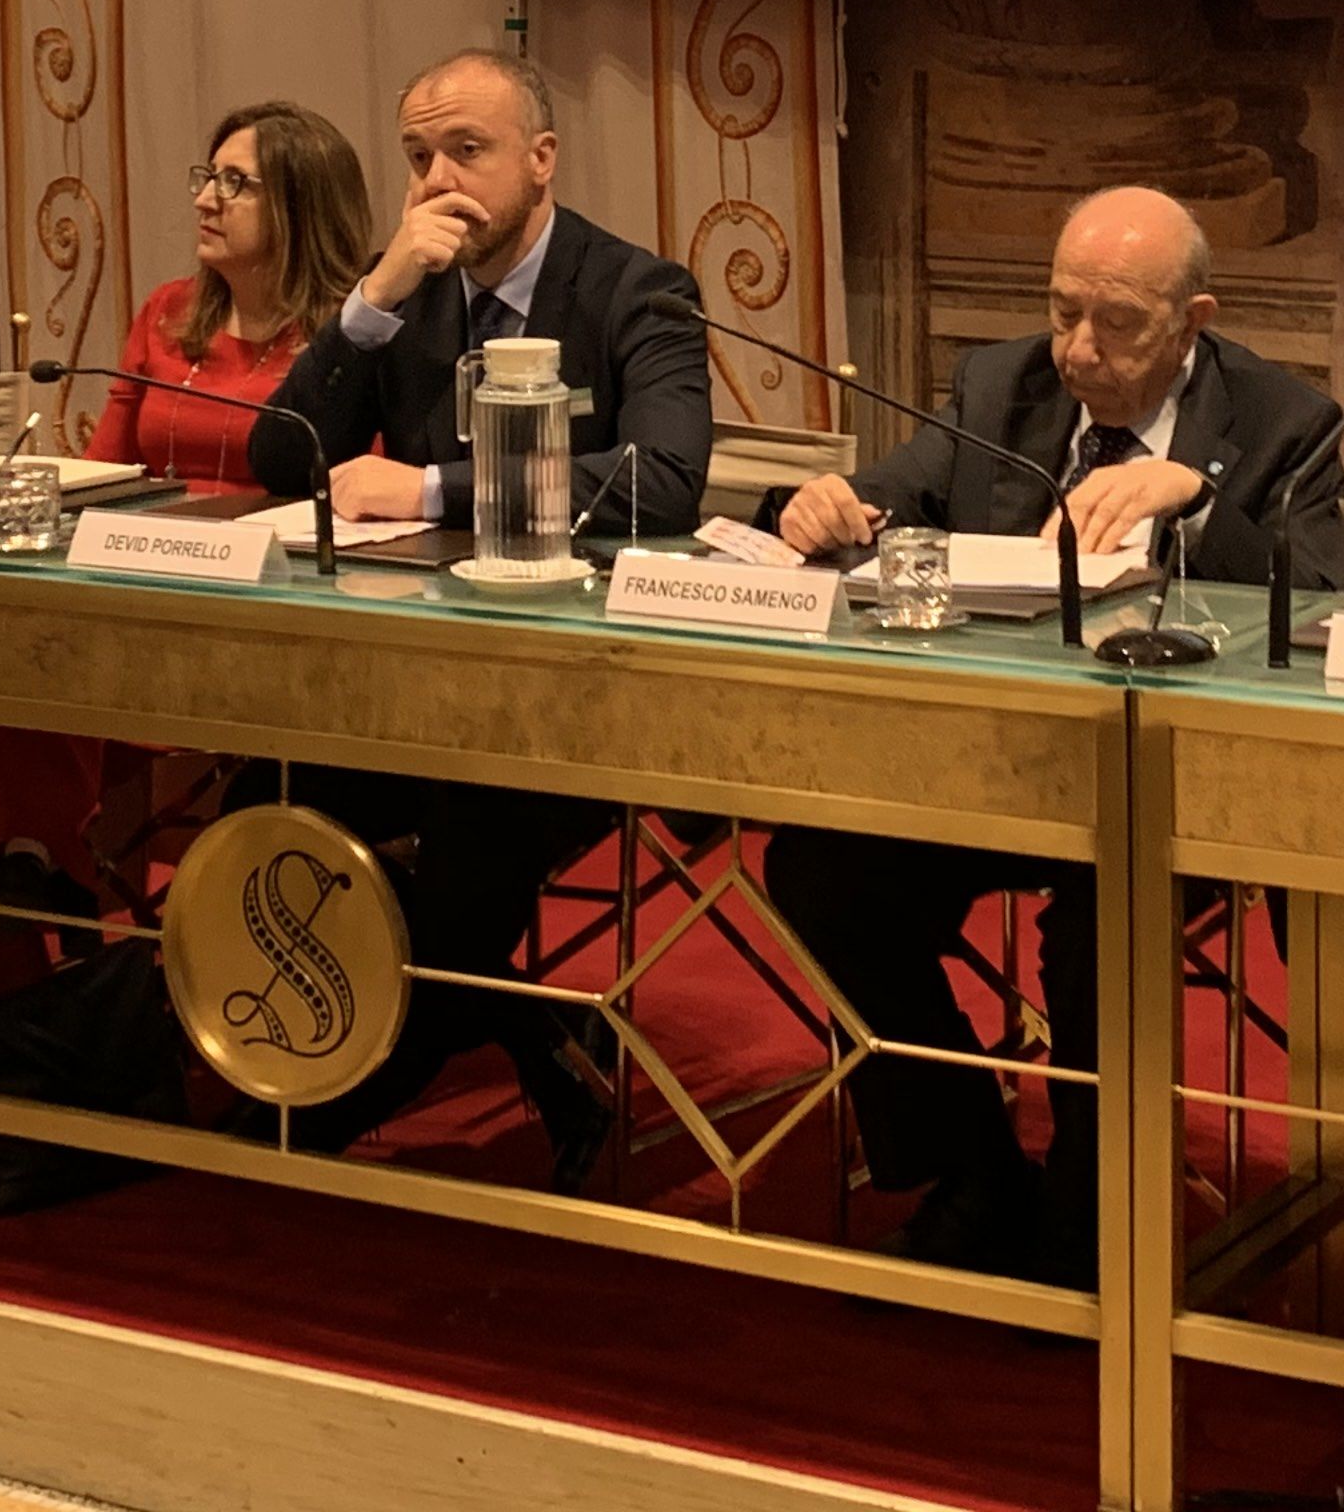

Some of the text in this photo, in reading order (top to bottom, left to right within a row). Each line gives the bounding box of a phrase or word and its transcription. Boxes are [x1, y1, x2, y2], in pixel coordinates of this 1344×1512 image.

[105, 534, 231, 560] DEVID PORRELLO
[624, 576, 817, 612] FRANCESCO SAMENGO
